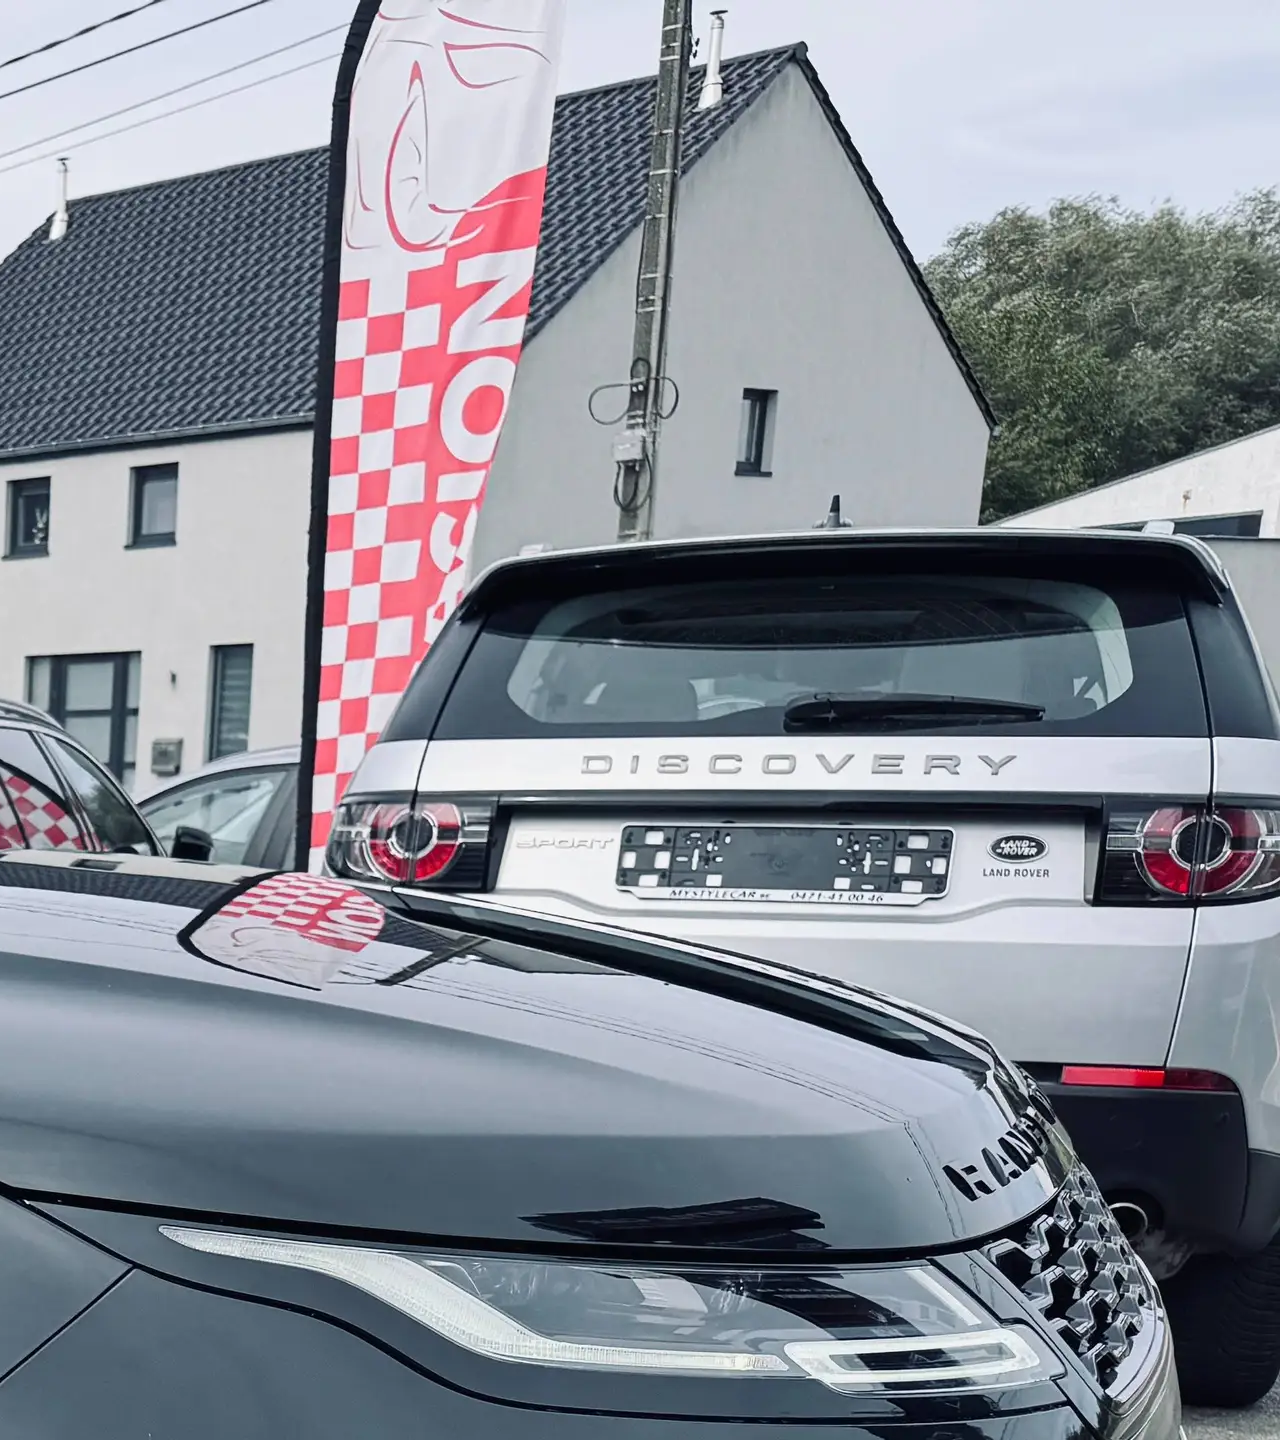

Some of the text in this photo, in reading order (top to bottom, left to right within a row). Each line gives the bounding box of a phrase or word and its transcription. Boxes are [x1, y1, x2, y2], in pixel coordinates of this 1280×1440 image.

[581, 753, 1019, 777] DISCOVERY
[516, 837, 615, 849] SPORT
[983, 868, 1050, 878] LAND ROVER
